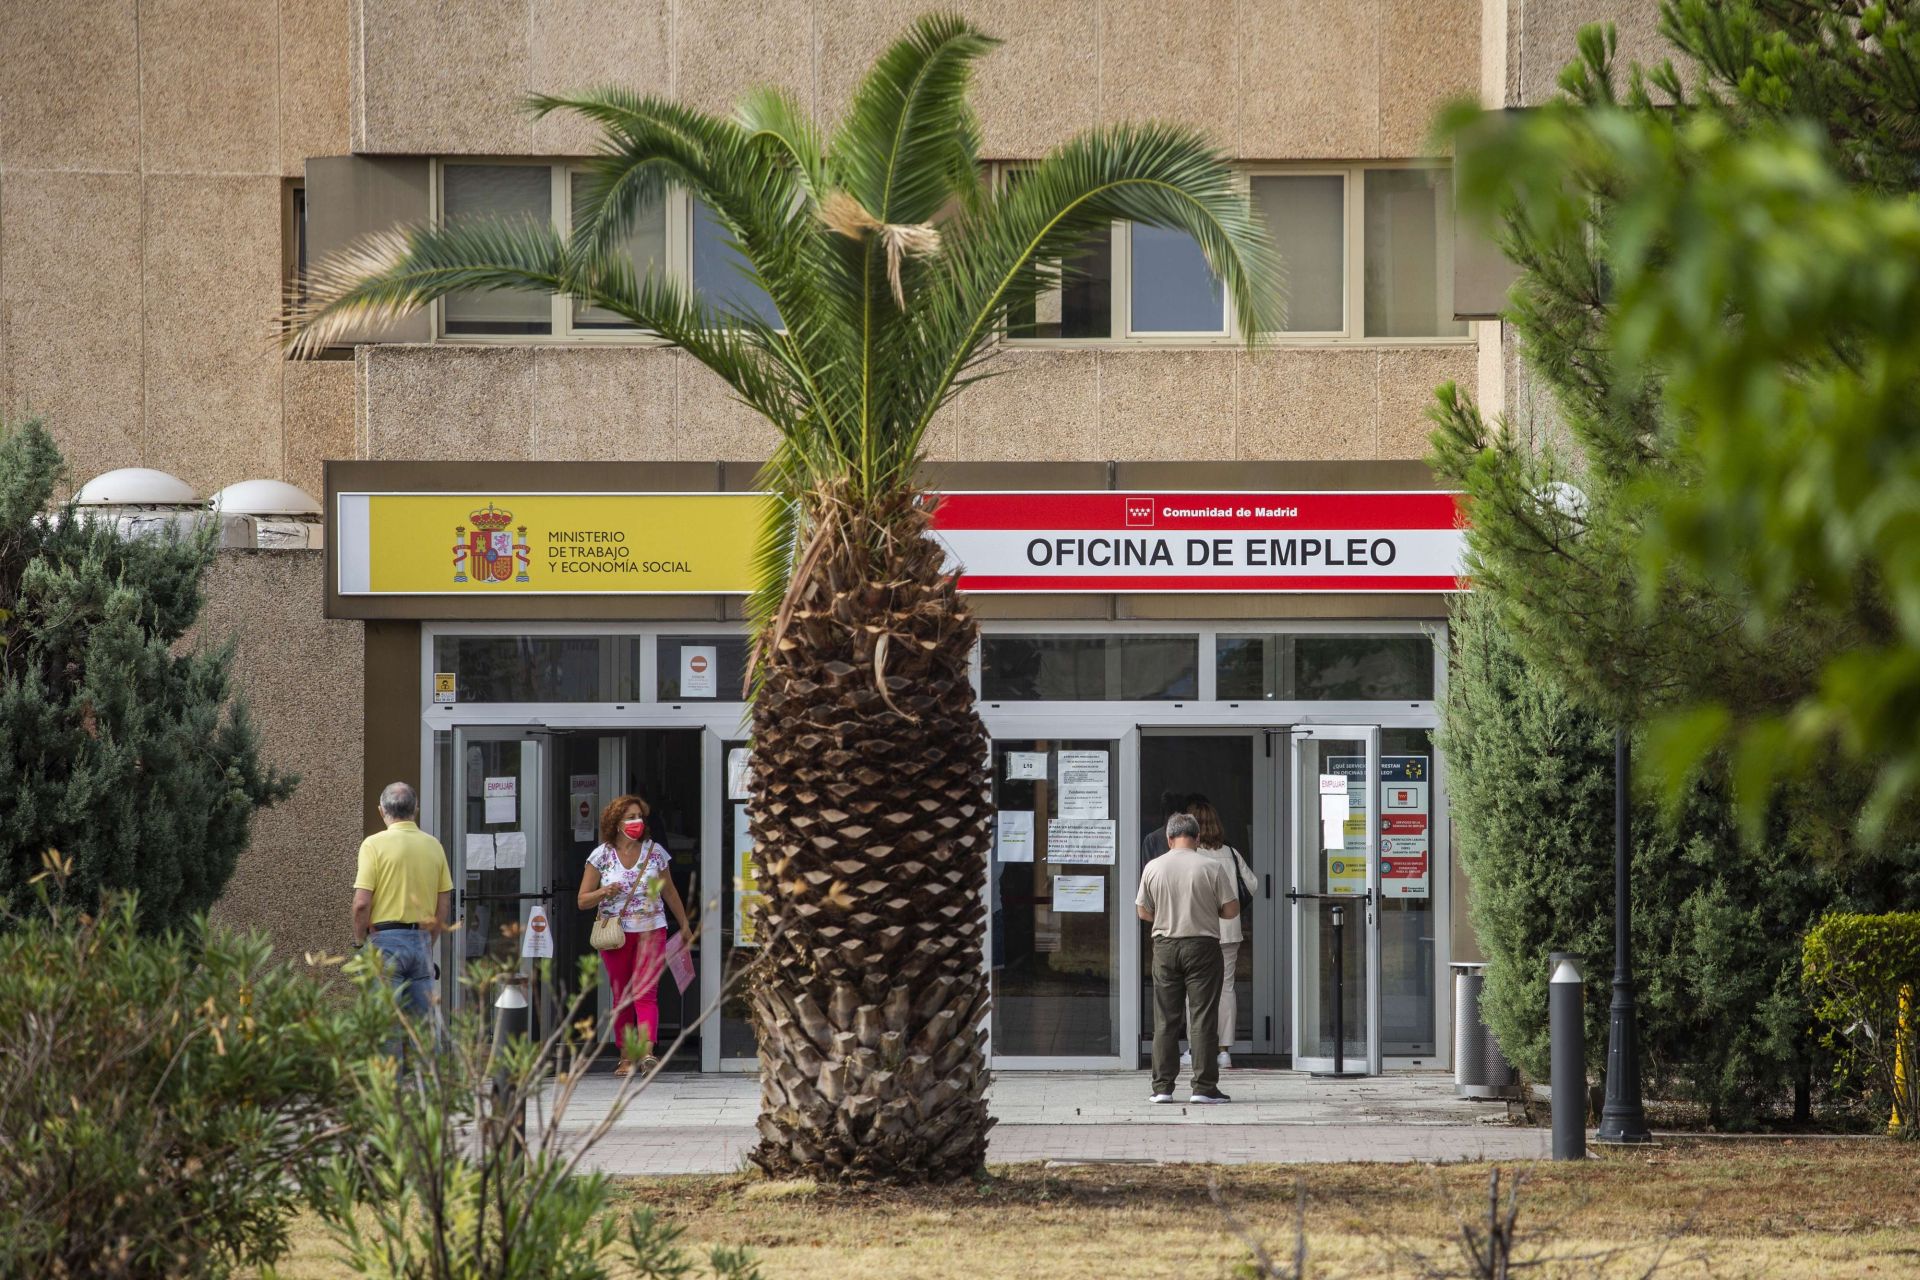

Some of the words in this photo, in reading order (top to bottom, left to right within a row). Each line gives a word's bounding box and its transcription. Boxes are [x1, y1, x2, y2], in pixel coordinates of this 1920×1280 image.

[1162, 507, 1233, 518] Comunidad
[1236, 507, 1252, 518] de
[1254, 506, 1298, 518] Madrid
[548, 531, 625, 543] MINISTERIO
[548, 546, 567, 558] DE
[569, 546, 630, 561] TRABAJO
[1026, 537, 1174, 567] OFICINA
[1186, 537, 1234, 567] DE
[1246, 537, 1397, 567] EMPLEO
[548, 560, 557, 573] Y
[561, 558, 639, 573] ECONOMÍA
[642, 560, 692, 573] SOCIAL
[488, 781, 514, 791] EMPUJAR
[1322, 779, 1346, 788] EMPUJAR
